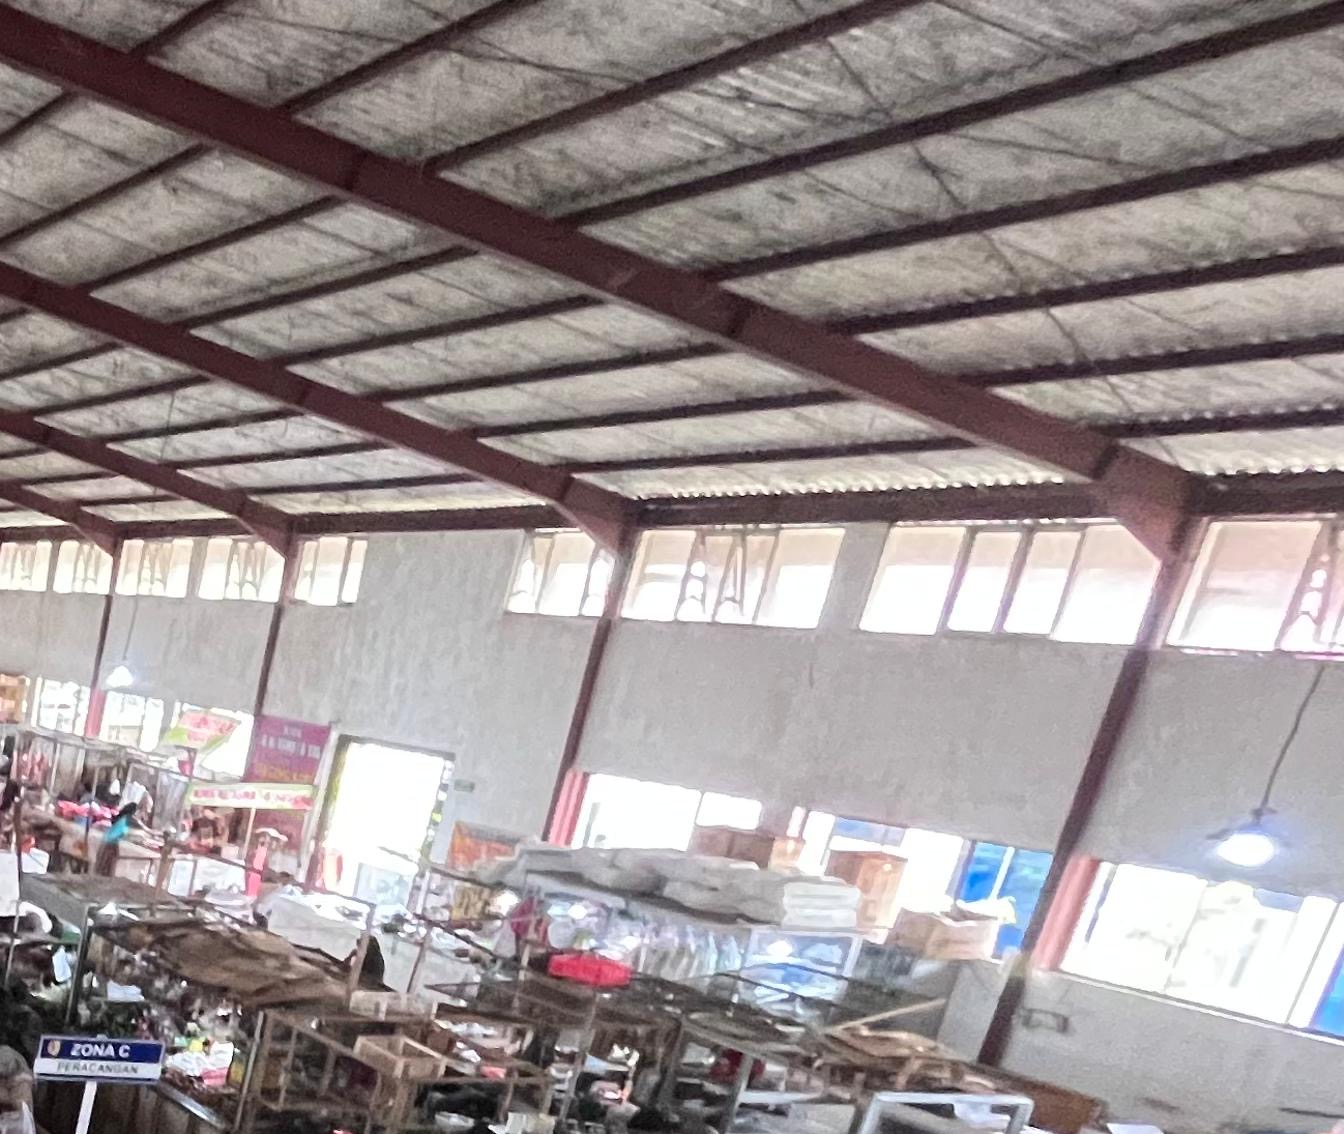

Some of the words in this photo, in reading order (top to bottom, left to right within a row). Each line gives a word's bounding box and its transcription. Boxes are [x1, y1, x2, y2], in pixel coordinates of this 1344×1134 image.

[71, 1044, 115, 1057] ZONA
[118, 1044, 131, 1059] C
[58, 1061, 138, 1074] PERACANGAN
